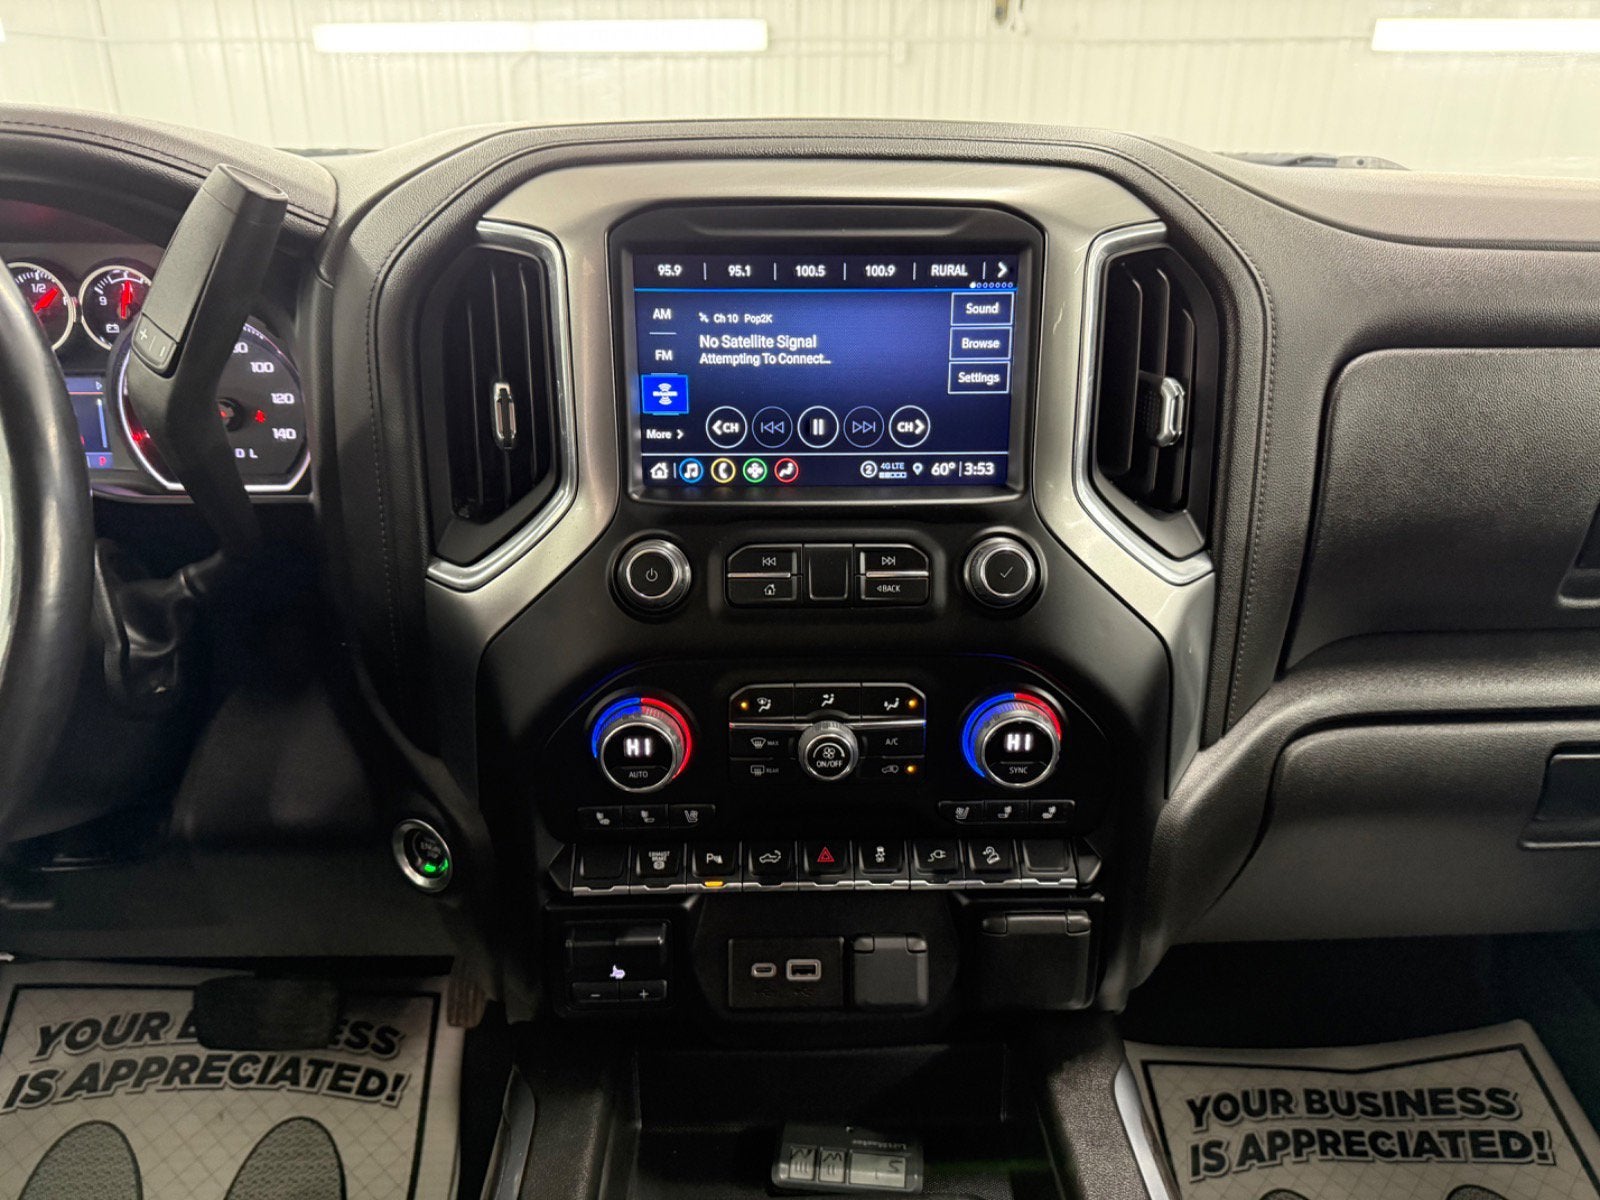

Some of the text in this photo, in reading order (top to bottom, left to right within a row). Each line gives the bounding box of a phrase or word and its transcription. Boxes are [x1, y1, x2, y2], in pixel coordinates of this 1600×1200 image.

[657, 264, 682, 277] 95.9
[728, 265, 751, 277] 95.1
[795, 265, 826, 277] 100.5
[865, 265, 895, 277] 100.9
[931, 264, 968, 277] RURAL
[31, 283, 47, 293] 1/2
[99, 296, 107, 306] 9
[652, 308, 672, 320] AM
[965, 302, 999, 315] Sound
[713, 313, 738, 323] Ch 10
[744, 313, 773, 325] Pop2K
[699, 335, 817, 352] No Satellite Signal
[961, 336, 1000, 349] Browse
[655, 350, 673, 361] FM
[699, 353, 760, 367] Attempting
[762, 352, 777, 364] To
[250, 362, 275, 373] 100
[957, 370, 1000, 384] Settings
[271, 393, 295, 404] 120
[722, 421, 739, 434] CH
[896, 420, 912, 433] CH
[272, 428, 297, 439] 140
[646, 428, 672, 440] More
[892, 462, 905, 472] LTE
[963, 462, 994, 475] 3:53
[882, 584, 901, 593] BACK
[626, 738, 652, 756] HI
[885, 737, 898, 746] A/C
[1006, 733, 1034, 751] HI
[816, 760, 843, 769] ON/OFF
[1009, 766, 1029, 775] SYNC
[628, 771, 649, 779] AUTO
[34, 1010, 172, 1059] YOUR
[4, 1053, 410, 1111] IS APPRECIATED!
[1187, 1087, 1523, 1131] YOUR BUSINESS
[1190, 1129, 1557, 1180] IS APPRECIATED!
